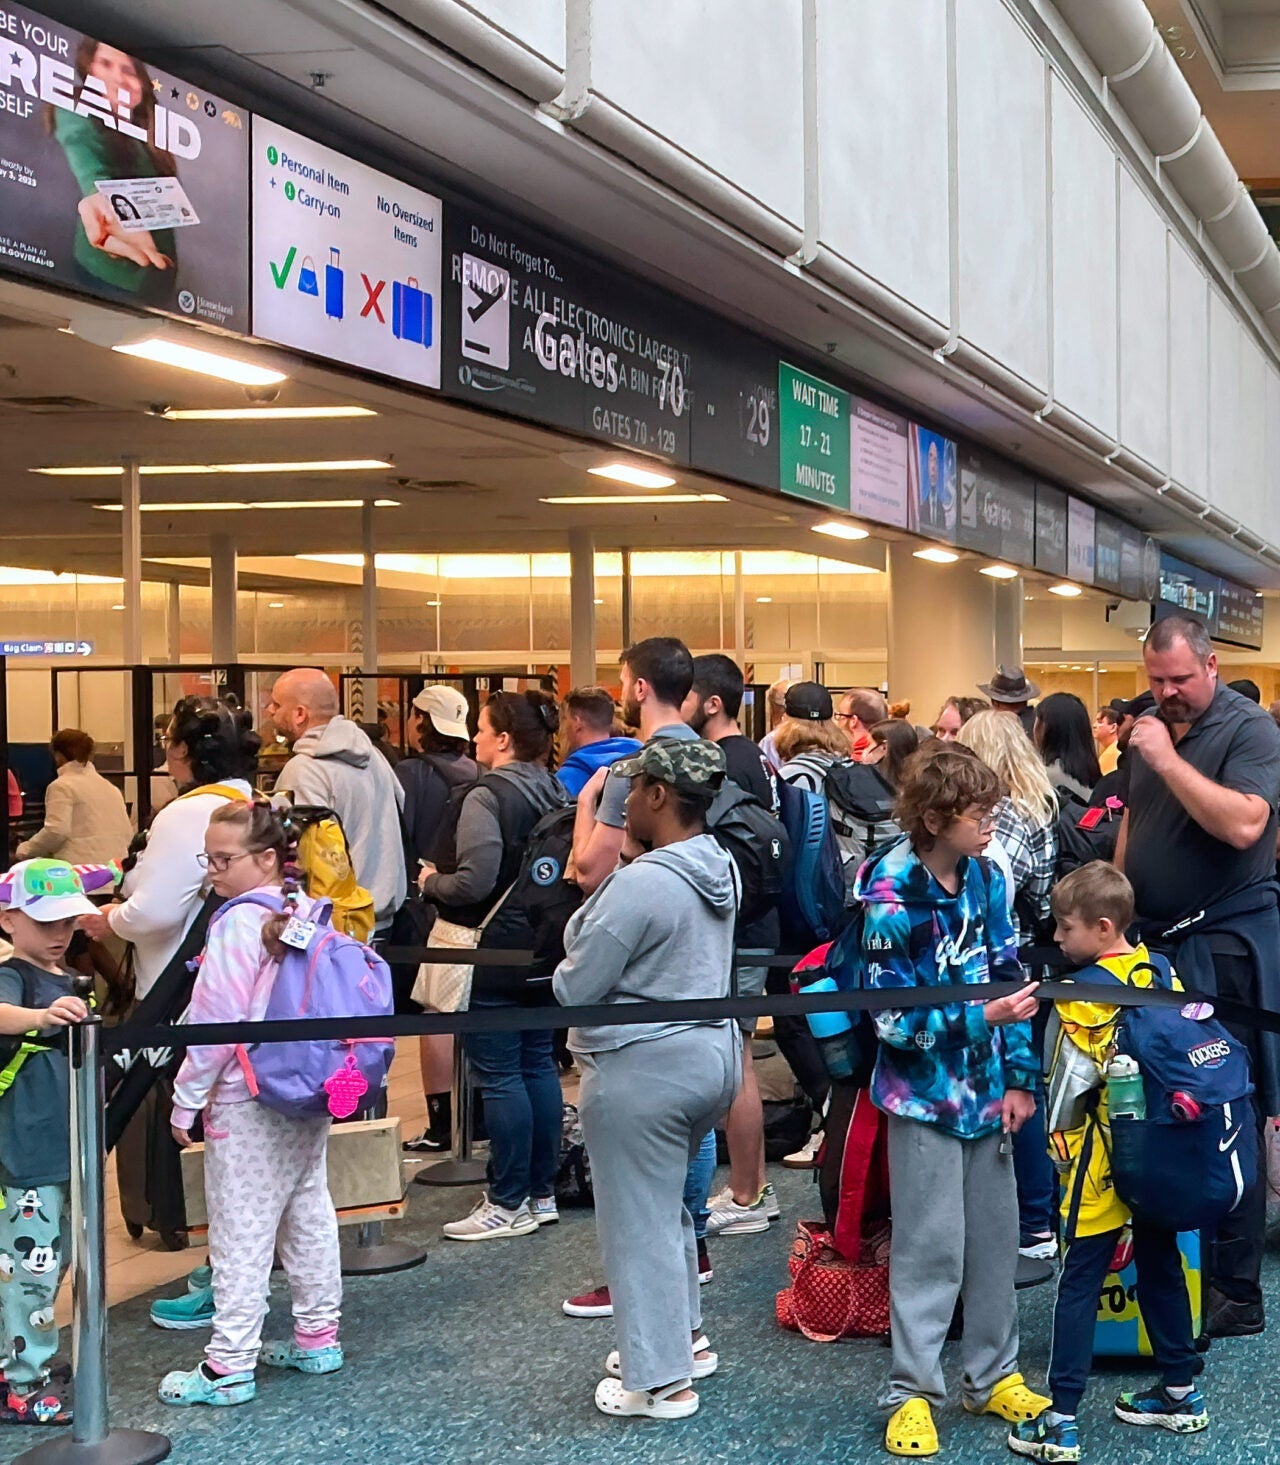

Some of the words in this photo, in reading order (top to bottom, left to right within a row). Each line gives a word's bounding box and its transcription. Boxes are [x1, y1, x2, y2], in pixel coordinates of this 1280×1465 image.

[20, 20, 69, 57] YOUR
[0, 35, 148, 143] REAL
[154, 104, 202, 161] ID
[281, 152, 325, 185] Personal
[327, 173, 350, 196] Item
[297, 188, 341, 219] Carry-on
[377, 195, 390, 214] No
[392, 203, 434, 233] Oversized
[394, 225, 418, 248] Items
[471, 225, 486, 248] Do
[489, 232, 508, 258] Not
[510, 243, 541, 273] Forget
[452, 253, 519, 306] REMOVE
[523, 285, 546, 316] ALL
[553, 296, 635, 353] ELECTRONICS
[638, 333, 680, 368] LARGER
[535, 312, 619, 393] Gates
[656, 358, 684, 417] 70
[630, 367, 649, 396] BIN
[792, 378, 816, 408] WAIT
[818, 388, 839, 418] TIME
[592, 406, 631, 442] GATES
[633, 419, 647, 445] 70
[657, 426, 676, 454] 129
[799, 424, 811, 448] 17
[820, 431, 831, 456] 21
[795, 462, 836, 495] MINUTES
[214, 670, 226, 684] 12
[540, 863, 550, 879] S
[1187, 1039, 1231, 1068] KICKERS
